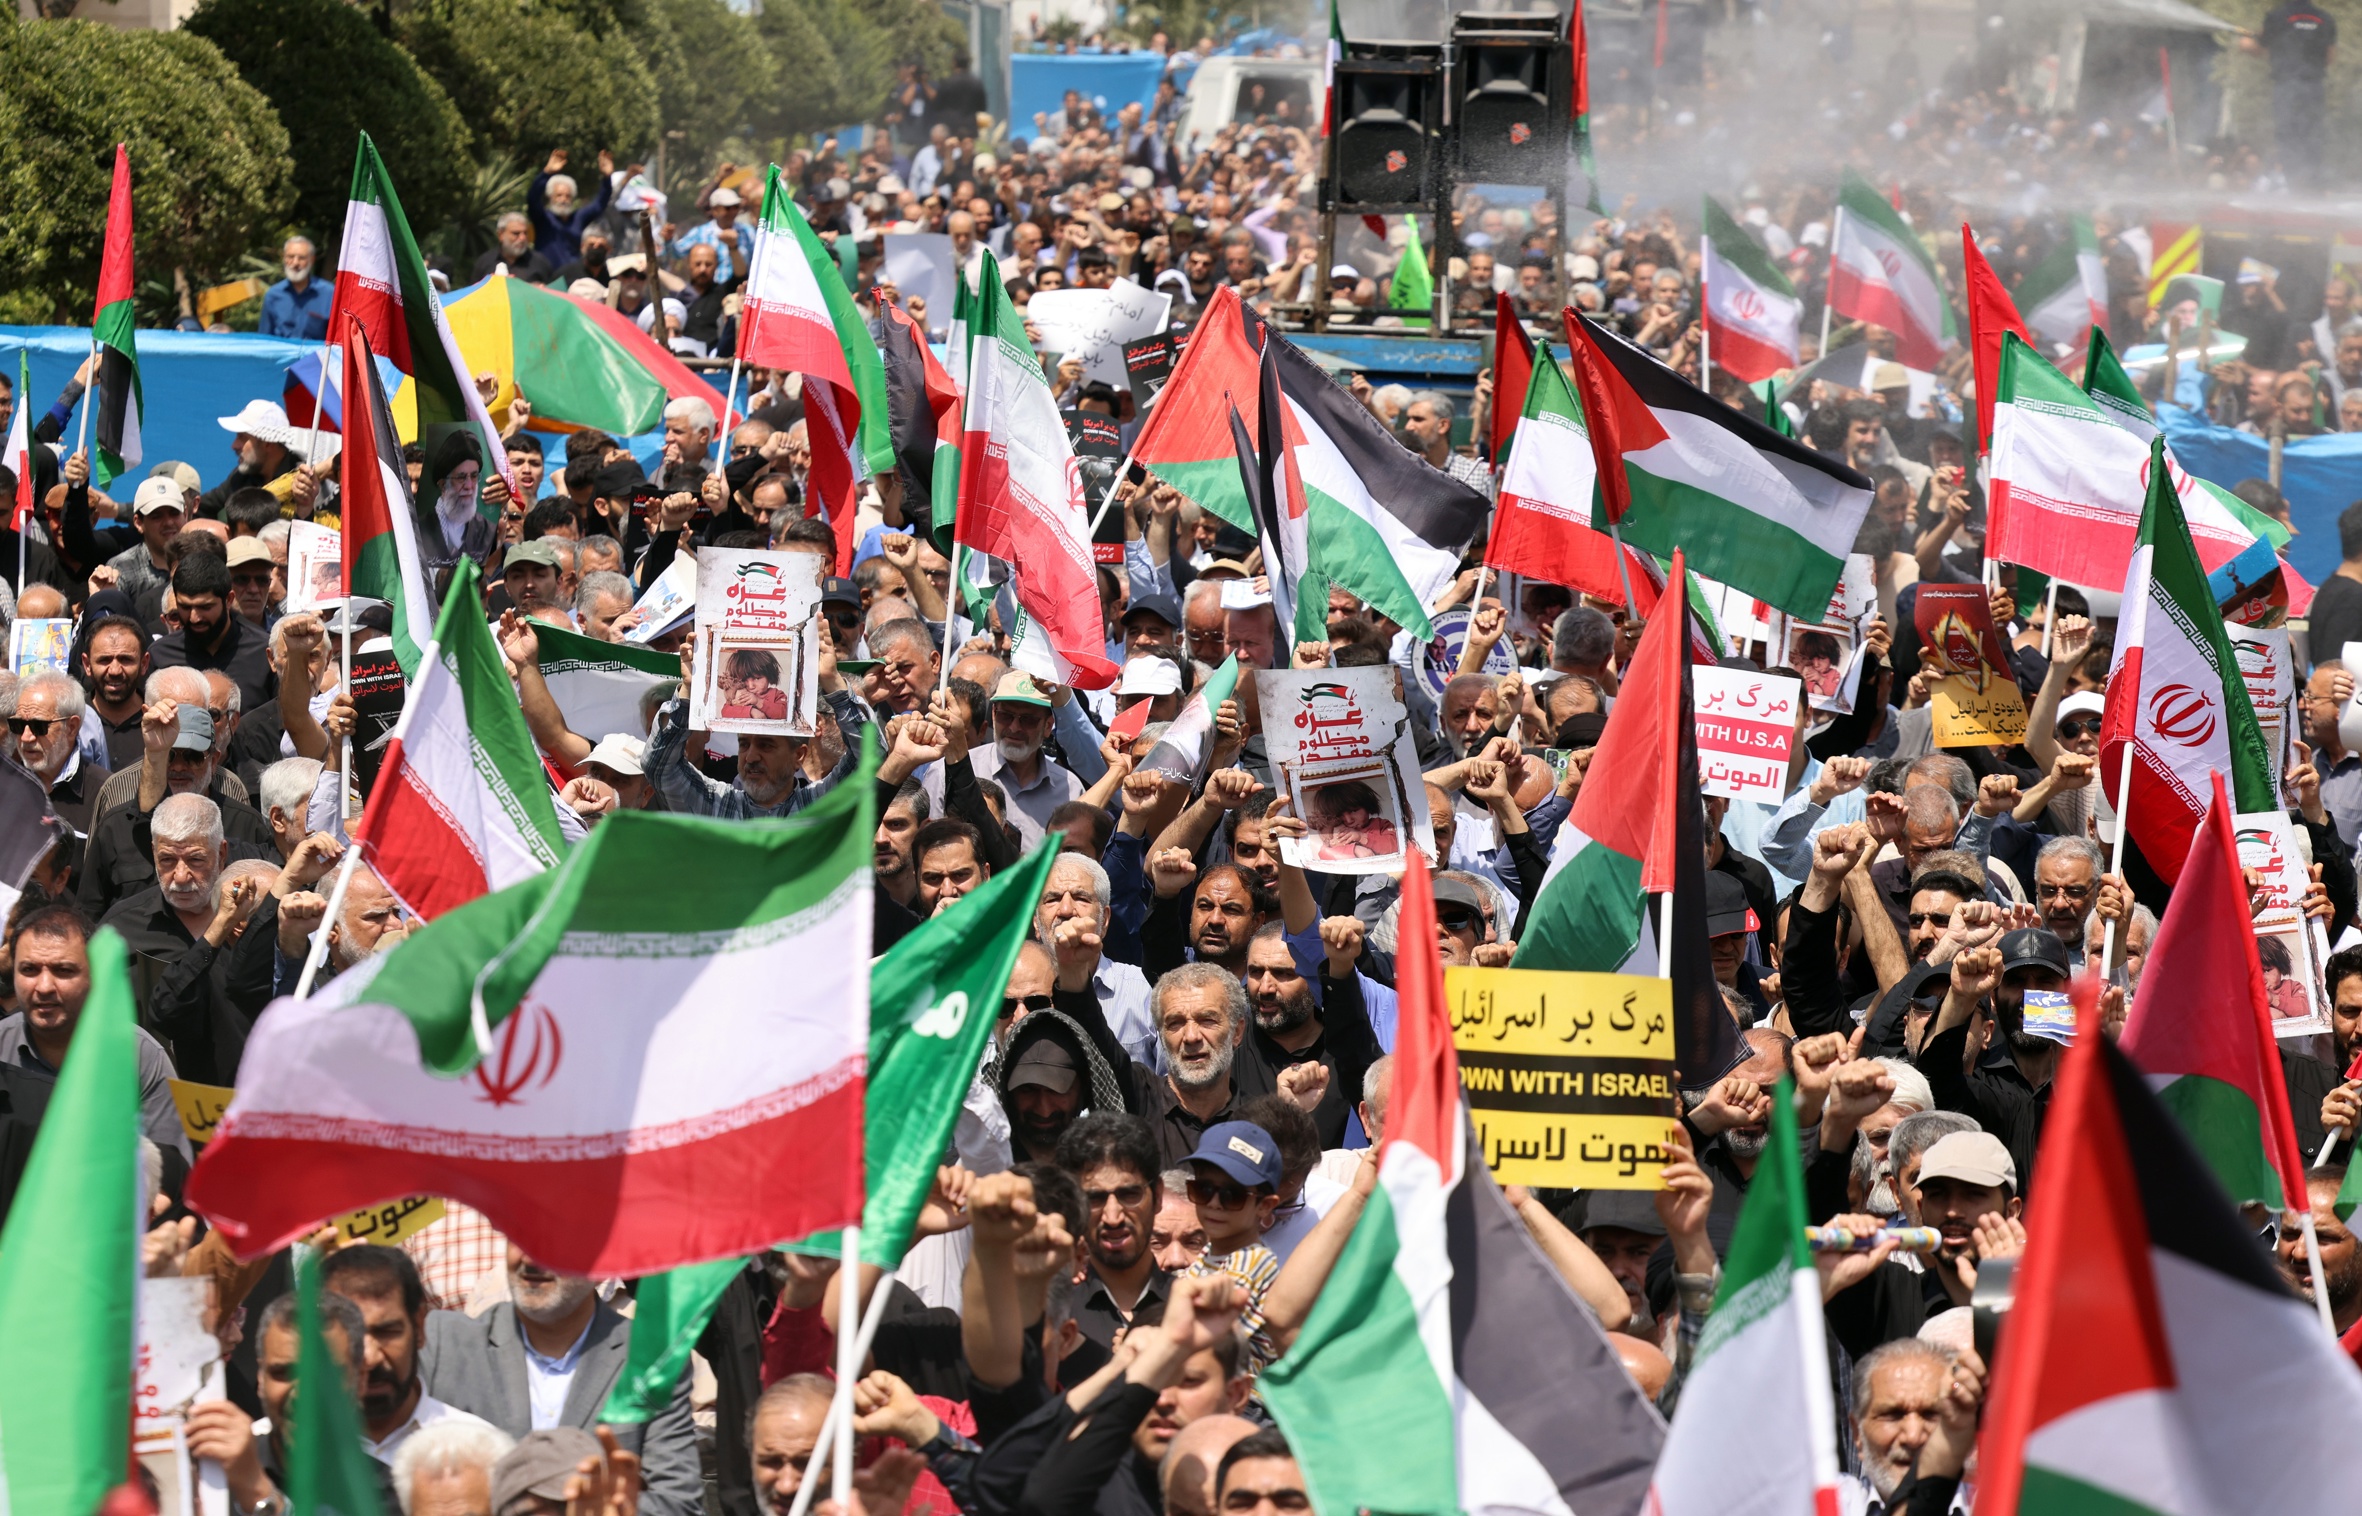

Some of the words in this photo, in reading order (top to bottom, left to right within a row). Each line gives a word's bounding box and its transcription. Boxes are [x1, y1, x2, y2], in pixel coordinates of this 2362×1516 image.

[727, 578, 786, 605] غزه
[726, 602, 787, 619] مظلوم
[725, 617, 787, 631] مقتدر
[383, 672, 403, 680] ISRAE
[1701, 690, 1725, 711] بر
[1736, 683, 1789, 717] مرگ
[1950, 698, 1991, 720] اسرائیل
[1993, 700, 2022, 718] نابودی
[1294, 699, 1364, 735] غزه
[1298, 730, 1370, 751] مظلوم
[1736, 728, 1787, 750] U.S.A
[1300, 744, 1373, 766] مقتدر
[1708, 762, 1779, 791] الموت
[1449, 989, 1546, 1040] اسرائیل
[1610, 990, 1665, 1044] مرگ
[1560, 1009, 1594, 1044] بر
[1510, 1070, 1584, 1095] WITH
[1592, 1073, 1673, 1098] ISRAEL
